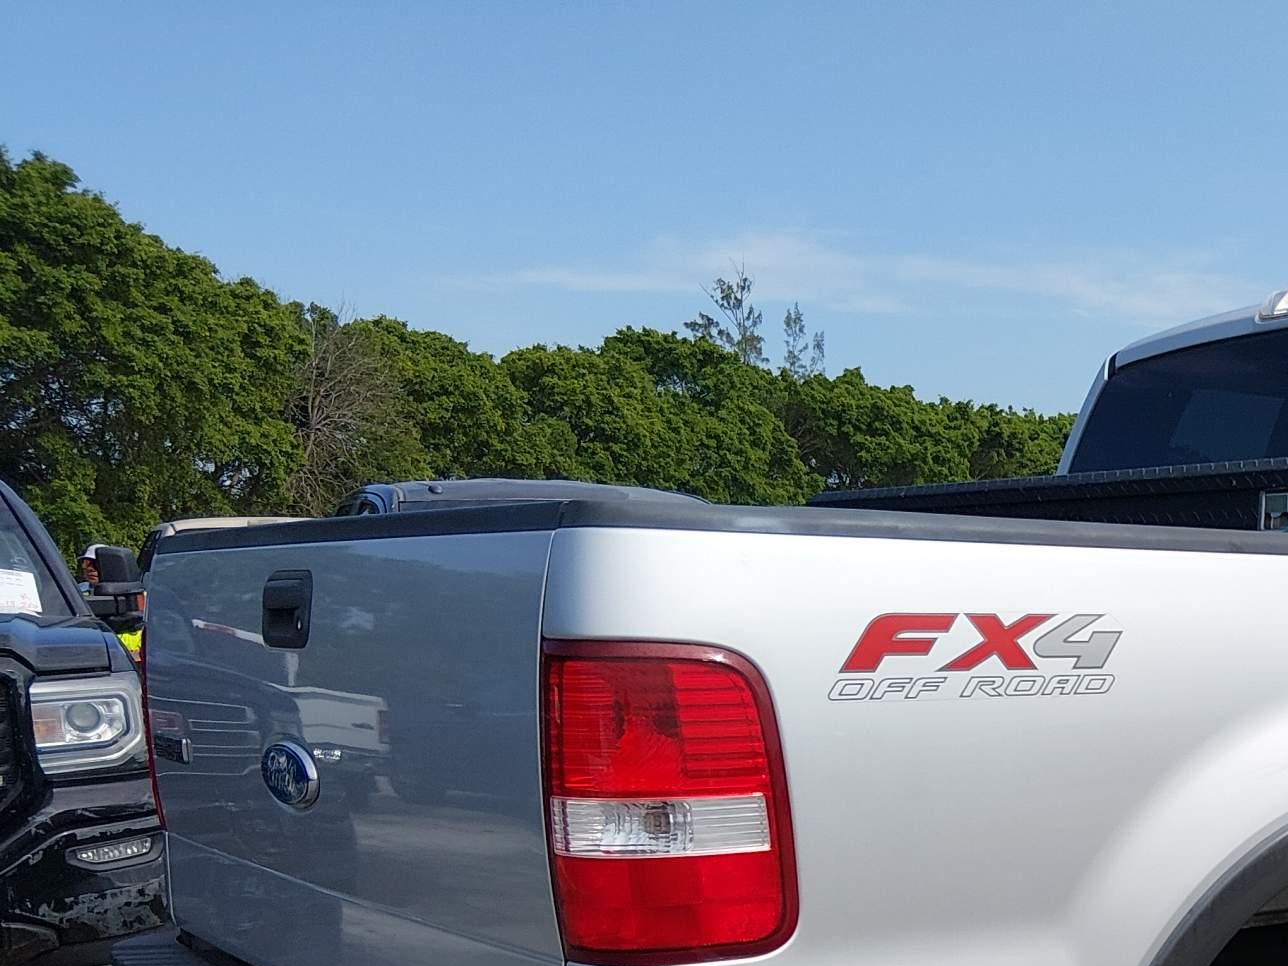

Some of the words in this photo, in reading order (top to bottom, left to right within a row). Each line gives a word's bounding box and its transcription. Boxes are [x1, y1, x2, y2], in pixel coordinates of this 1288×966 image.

[838, 612, 1123, 673] FX4
[828, 676, 948, 701] OFF
[959, 675, 1116, 698] ROAD
